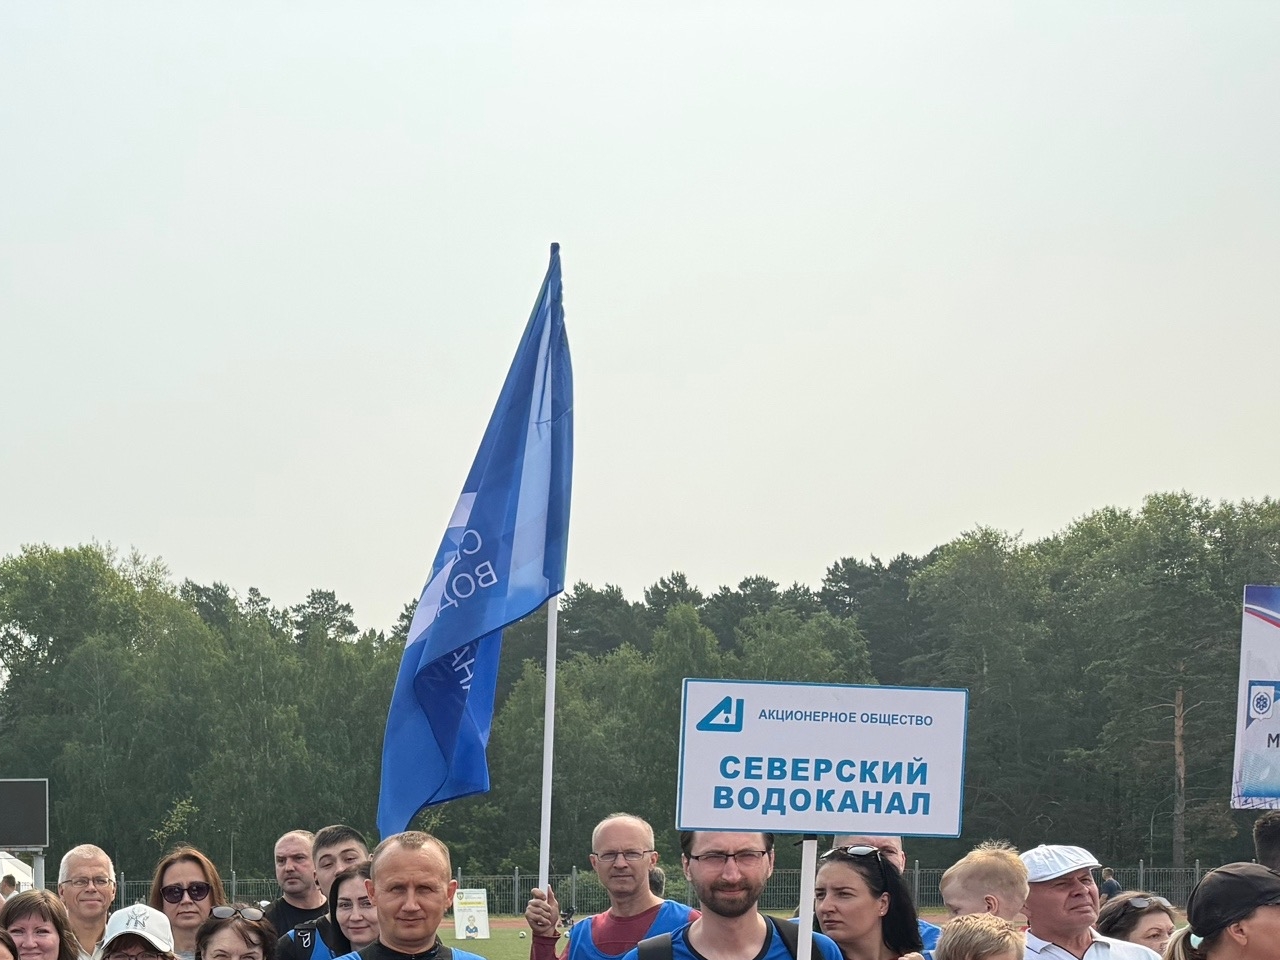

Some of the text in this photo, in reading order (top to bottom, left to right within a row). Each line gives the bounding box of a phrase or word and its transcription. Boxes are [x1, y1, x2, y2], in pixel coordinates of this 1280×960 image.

[758, 709, 933, 727] АКЦИОНЕРНОЕ ОБЩЕСТВО
[719, 756, 928, 785] СЕВЕРСКИЙ
[713, 785, 931, 816] ВОДОКАНАЛ
